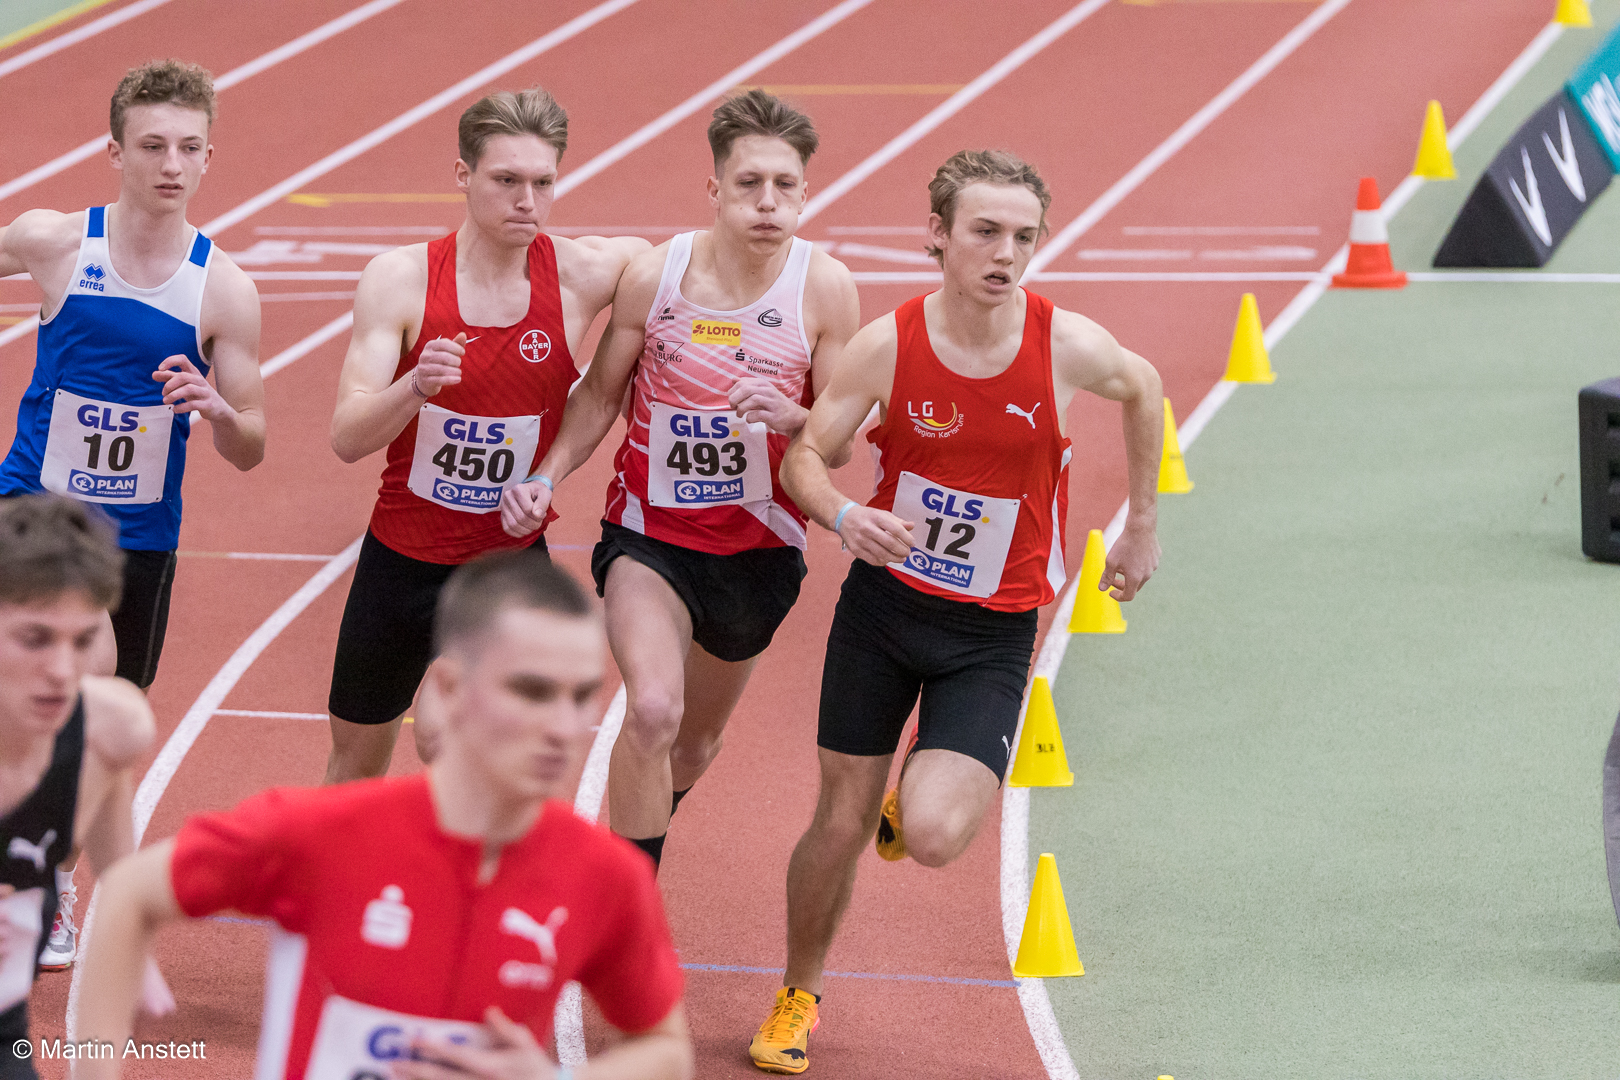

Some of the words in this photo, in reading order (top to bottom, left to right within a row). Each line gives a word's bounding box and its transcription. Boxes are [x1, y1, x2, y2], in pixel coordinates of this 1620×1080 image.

[79, 279, 105, 293] errea
[706, 325, 741, 337] LOTTO
[522, 342, 549, 351] BAYER
[532, 332, 540, 360] BAYER
[748, 355, 784, 368] Sparkasse
[747, 365, 779, 376] Neuwied
[913, 424, 936, 439] Region
[83, 433, 135, 471] 10
[666, 440, 748, 476] 493
[432, 442, 515, 484] 450
[96, 479, 135, 490] PLAN
[702, 482, 741, 495] PLAN
[460, 488, 500, 501] PLAN
[924, 516, 976, 560] 12
[931, 561, 971, 580] PLAN
